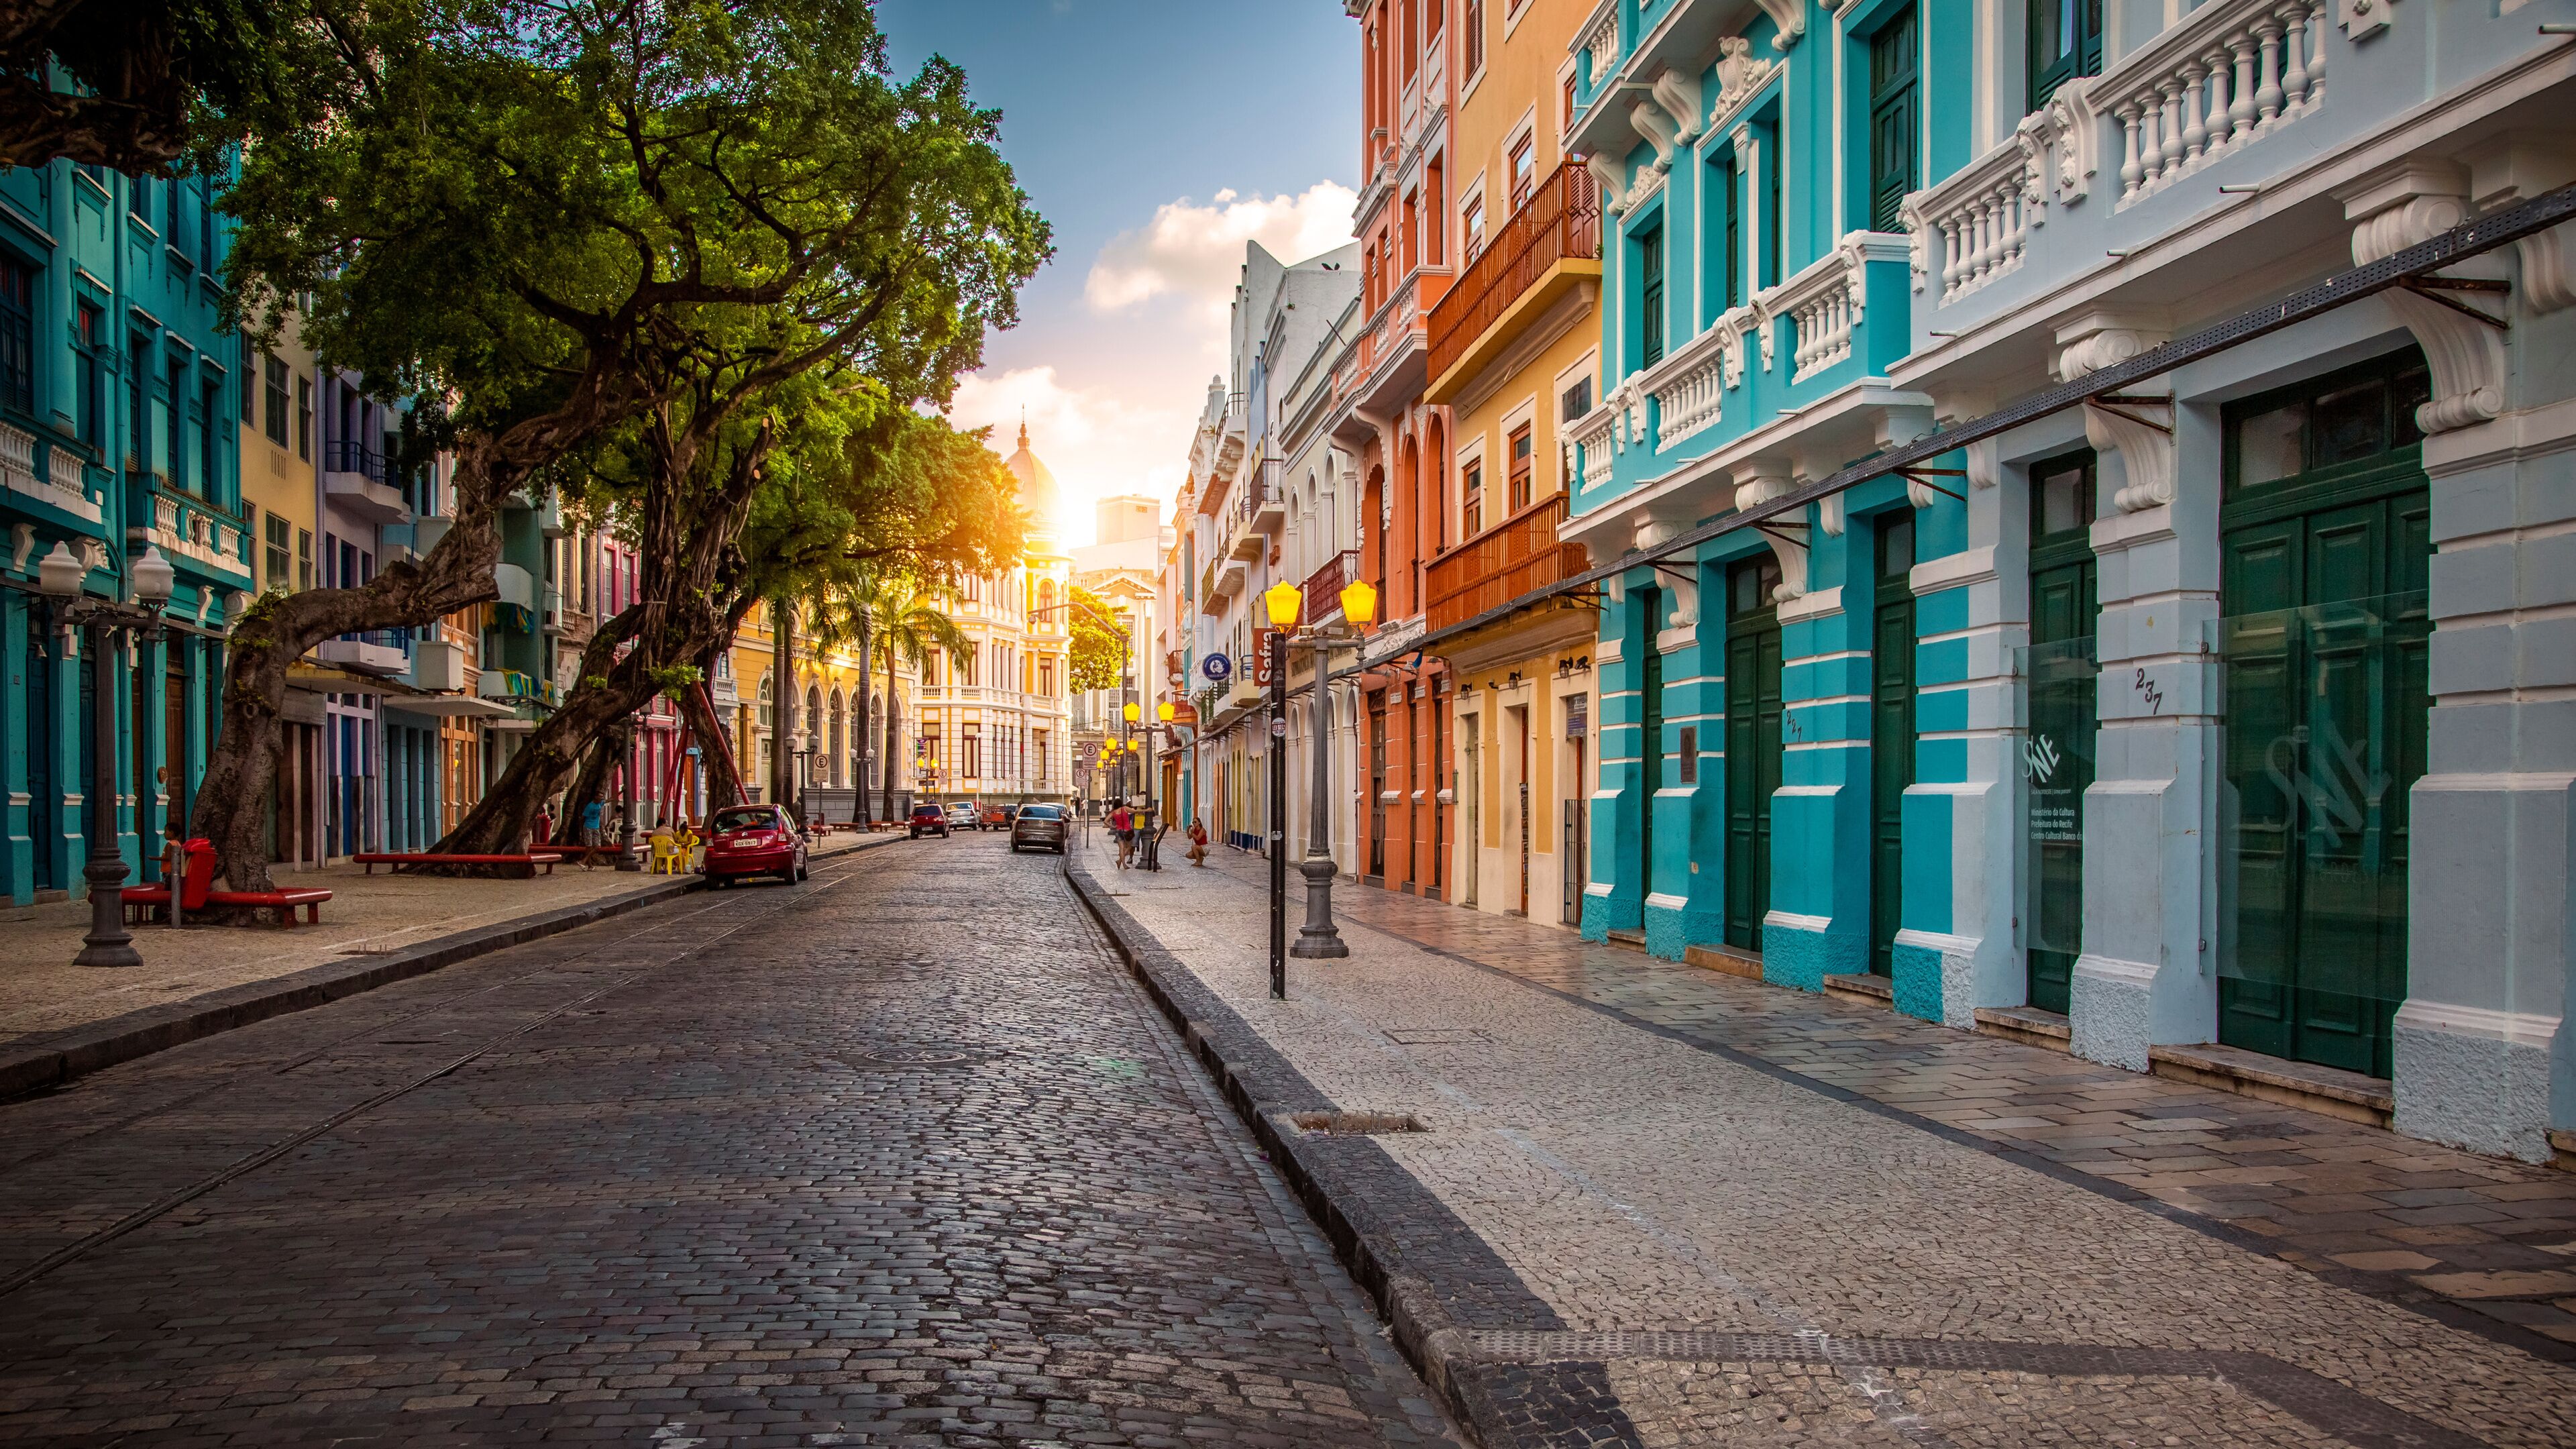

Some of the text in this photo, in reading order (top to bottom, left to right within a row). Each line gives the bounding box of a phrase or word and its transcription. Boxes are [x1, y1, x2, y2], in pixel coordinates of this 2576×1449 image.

[1258, 632, 1273, 682] Safra
[2135, 667, 2162, 715] 237
[1787, 710, 1802, 742] 227
[2031, 807, 2075, 816] Ministério da Cultura
[2031, 819, 2073, 828] Prefeitura do Recife
[2045, 831, 2061, 840] Cultural
[2062, 833, 2076, 841] Banco
